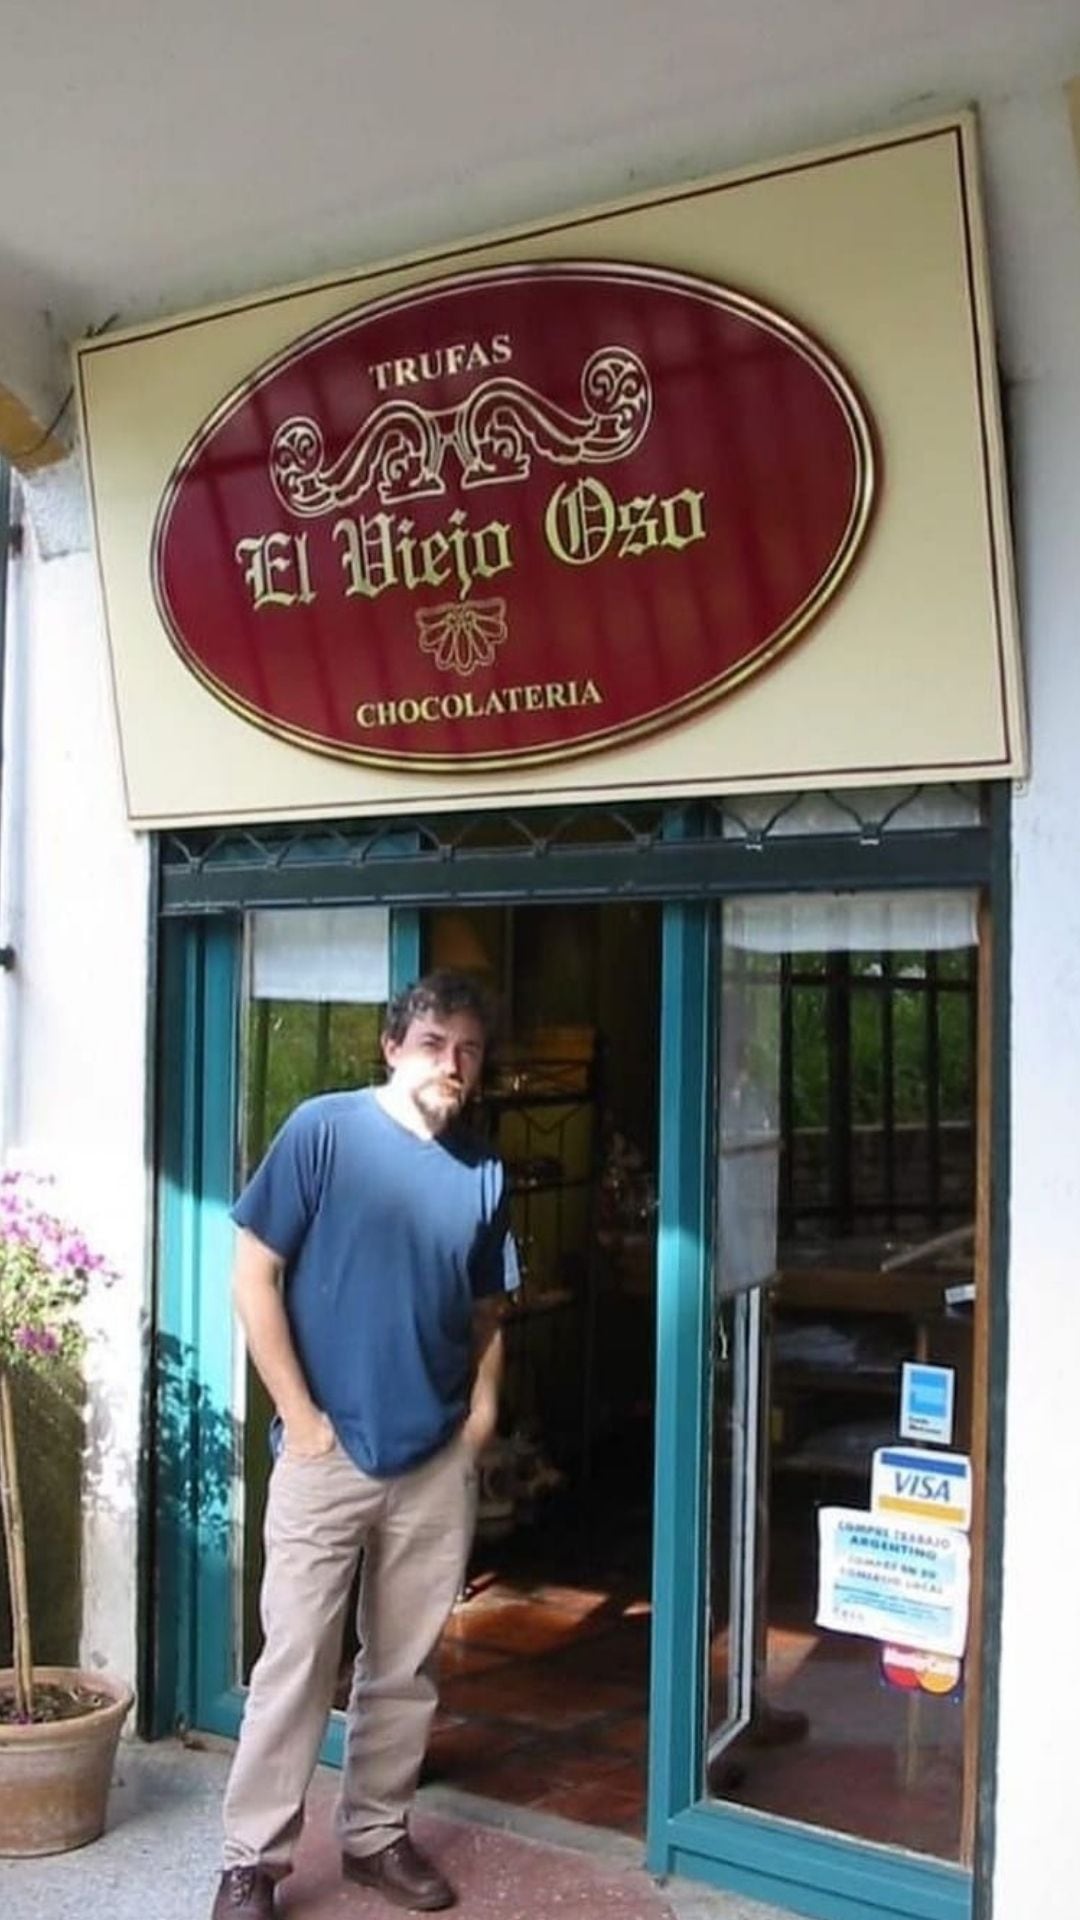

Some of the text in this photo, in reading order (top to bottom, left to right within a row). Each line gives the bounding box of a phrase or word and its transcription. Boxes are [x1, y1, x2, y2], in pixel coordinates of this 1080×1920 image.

[369, 334, 513, 390] TRUFAS
[236, 476, 707, 610] El Viejo Oso
[355, 680, 603, 728] CHOCOLATERIA
[893, 1471, 952, 1503] VISA
[850, 1535, 938, 1561] ARGENTINO
